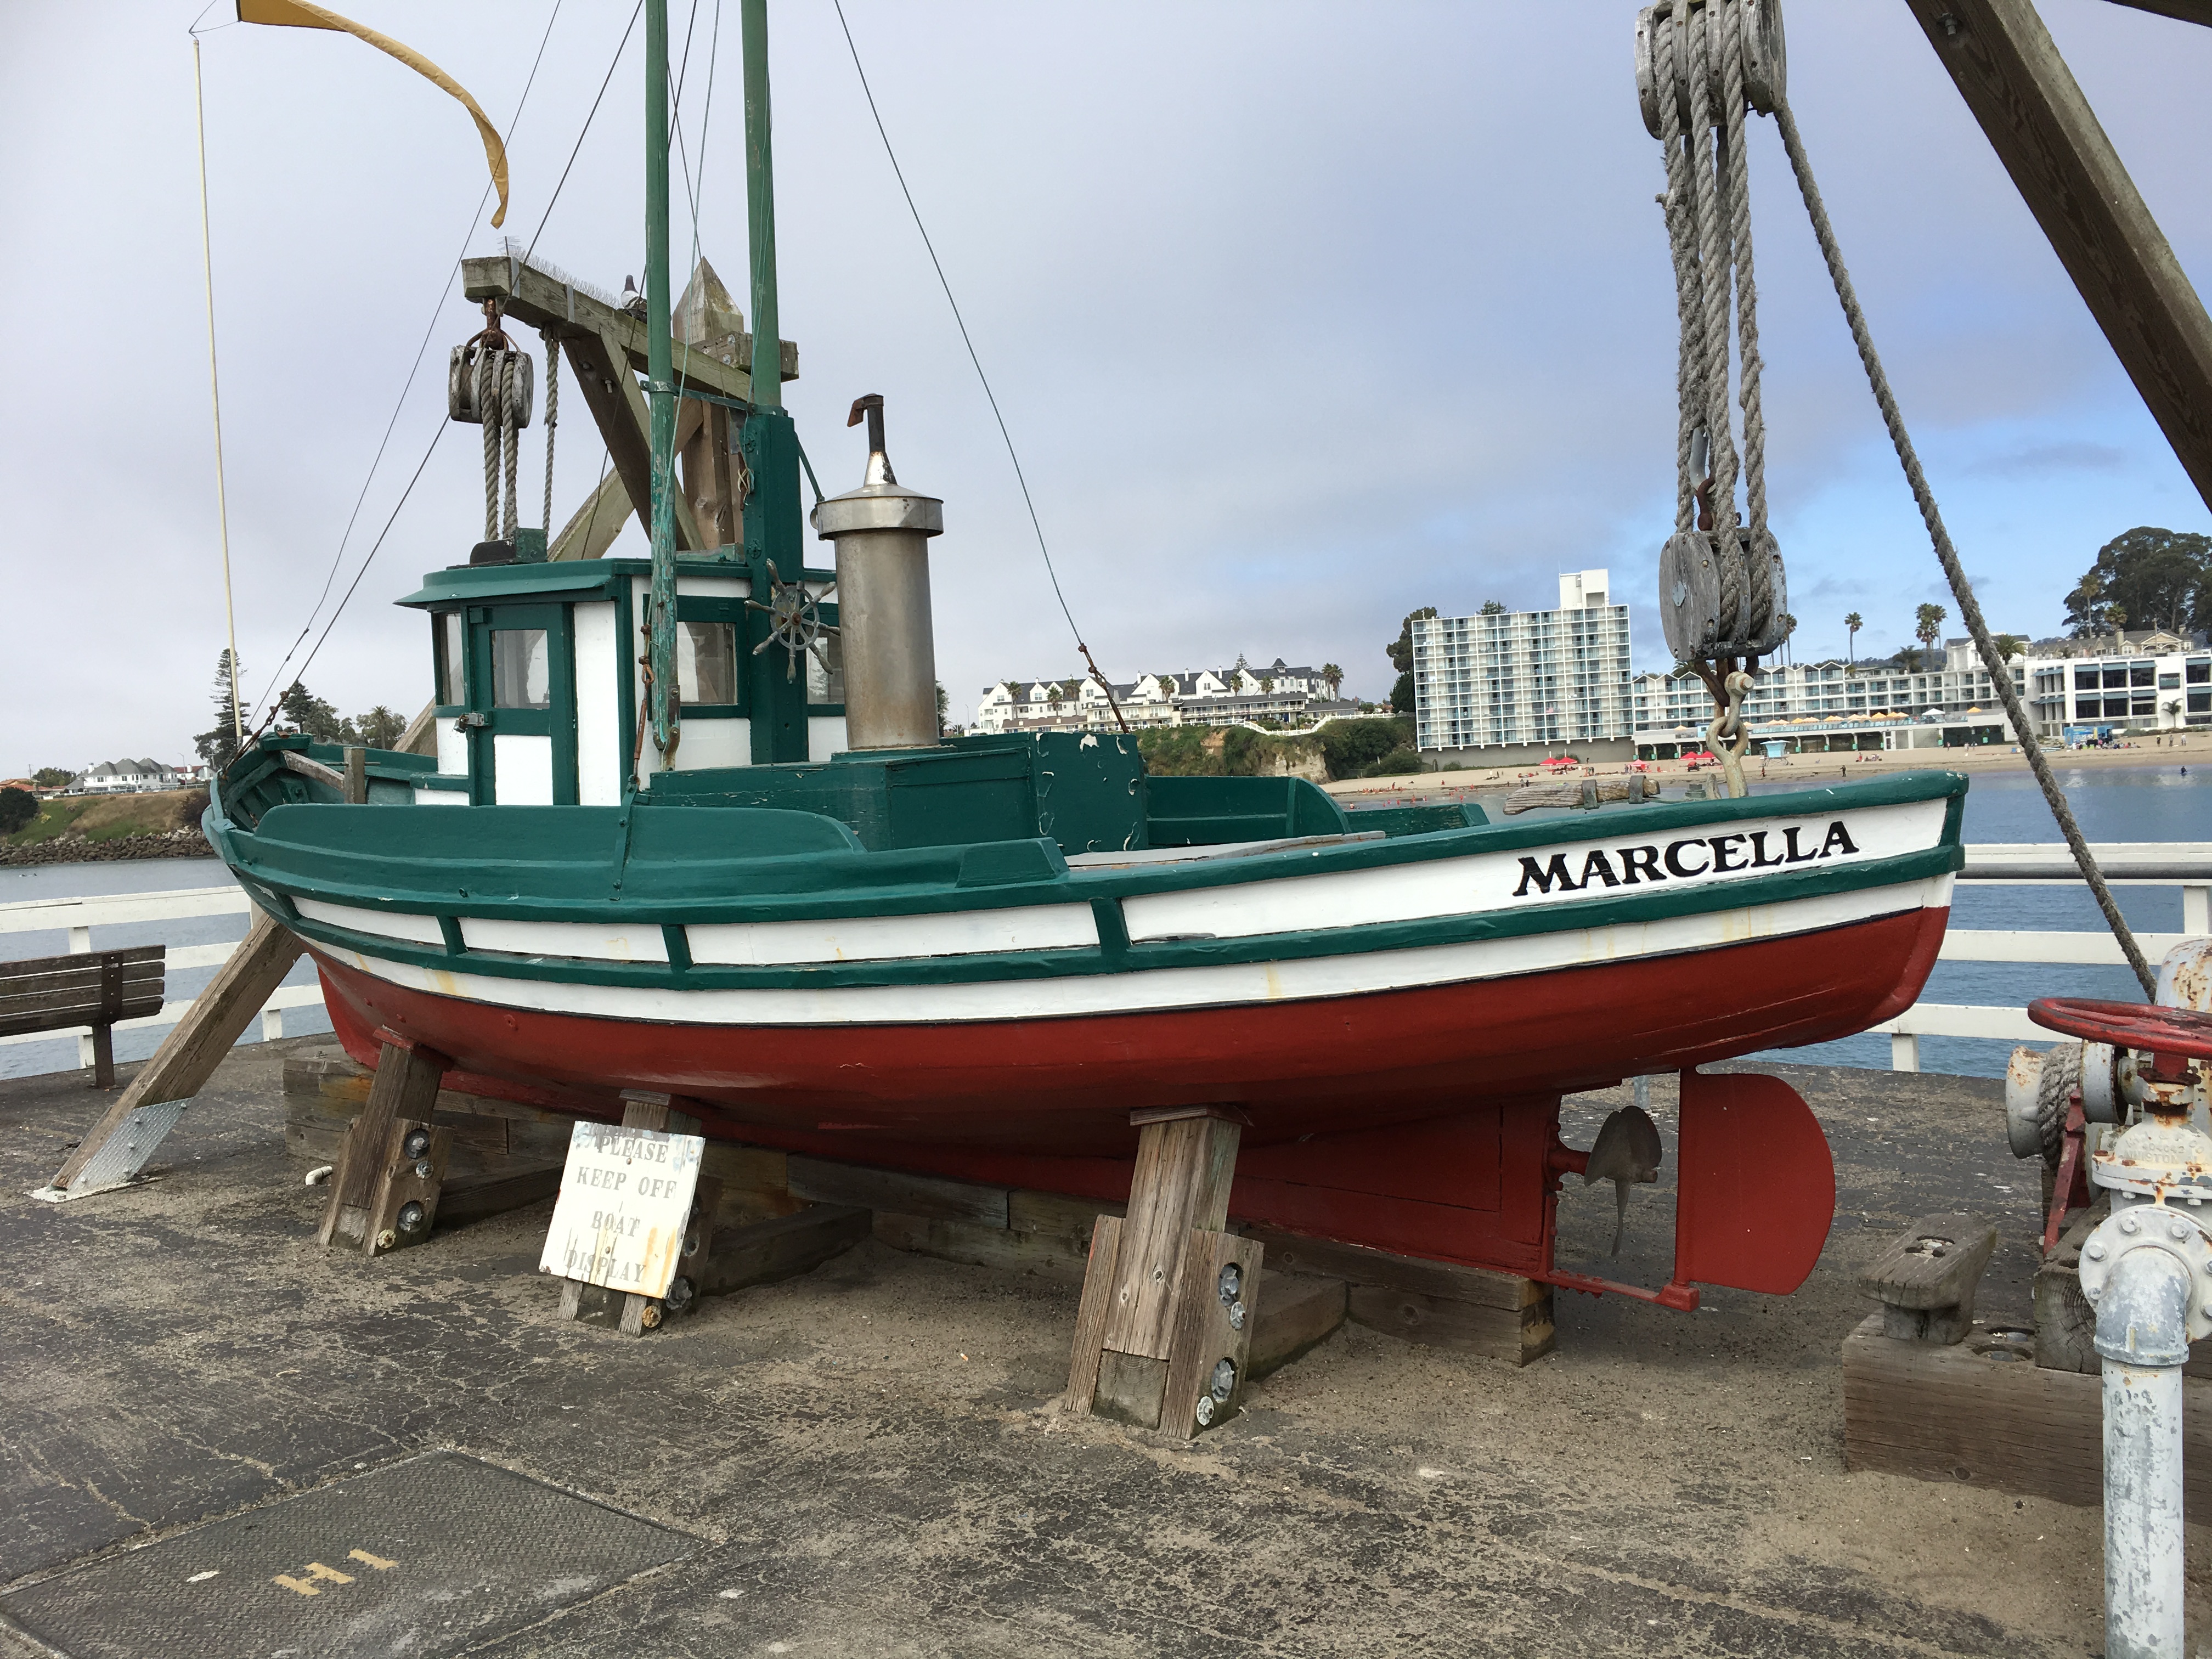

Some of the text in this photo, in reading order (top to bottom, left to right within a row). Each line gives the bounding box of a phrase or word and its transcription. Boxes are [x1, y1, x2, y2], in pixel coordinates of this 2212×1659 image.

[1513, 821, 1859, 896] MARCELLA
[597, 1135, 669, 1164] PLEASE
[577, 1166, 678, 1199] KEEP OFF
[590, 1210, 641, 1237] BOAT
[565, 1249, 647, 1283] DISPLAY
